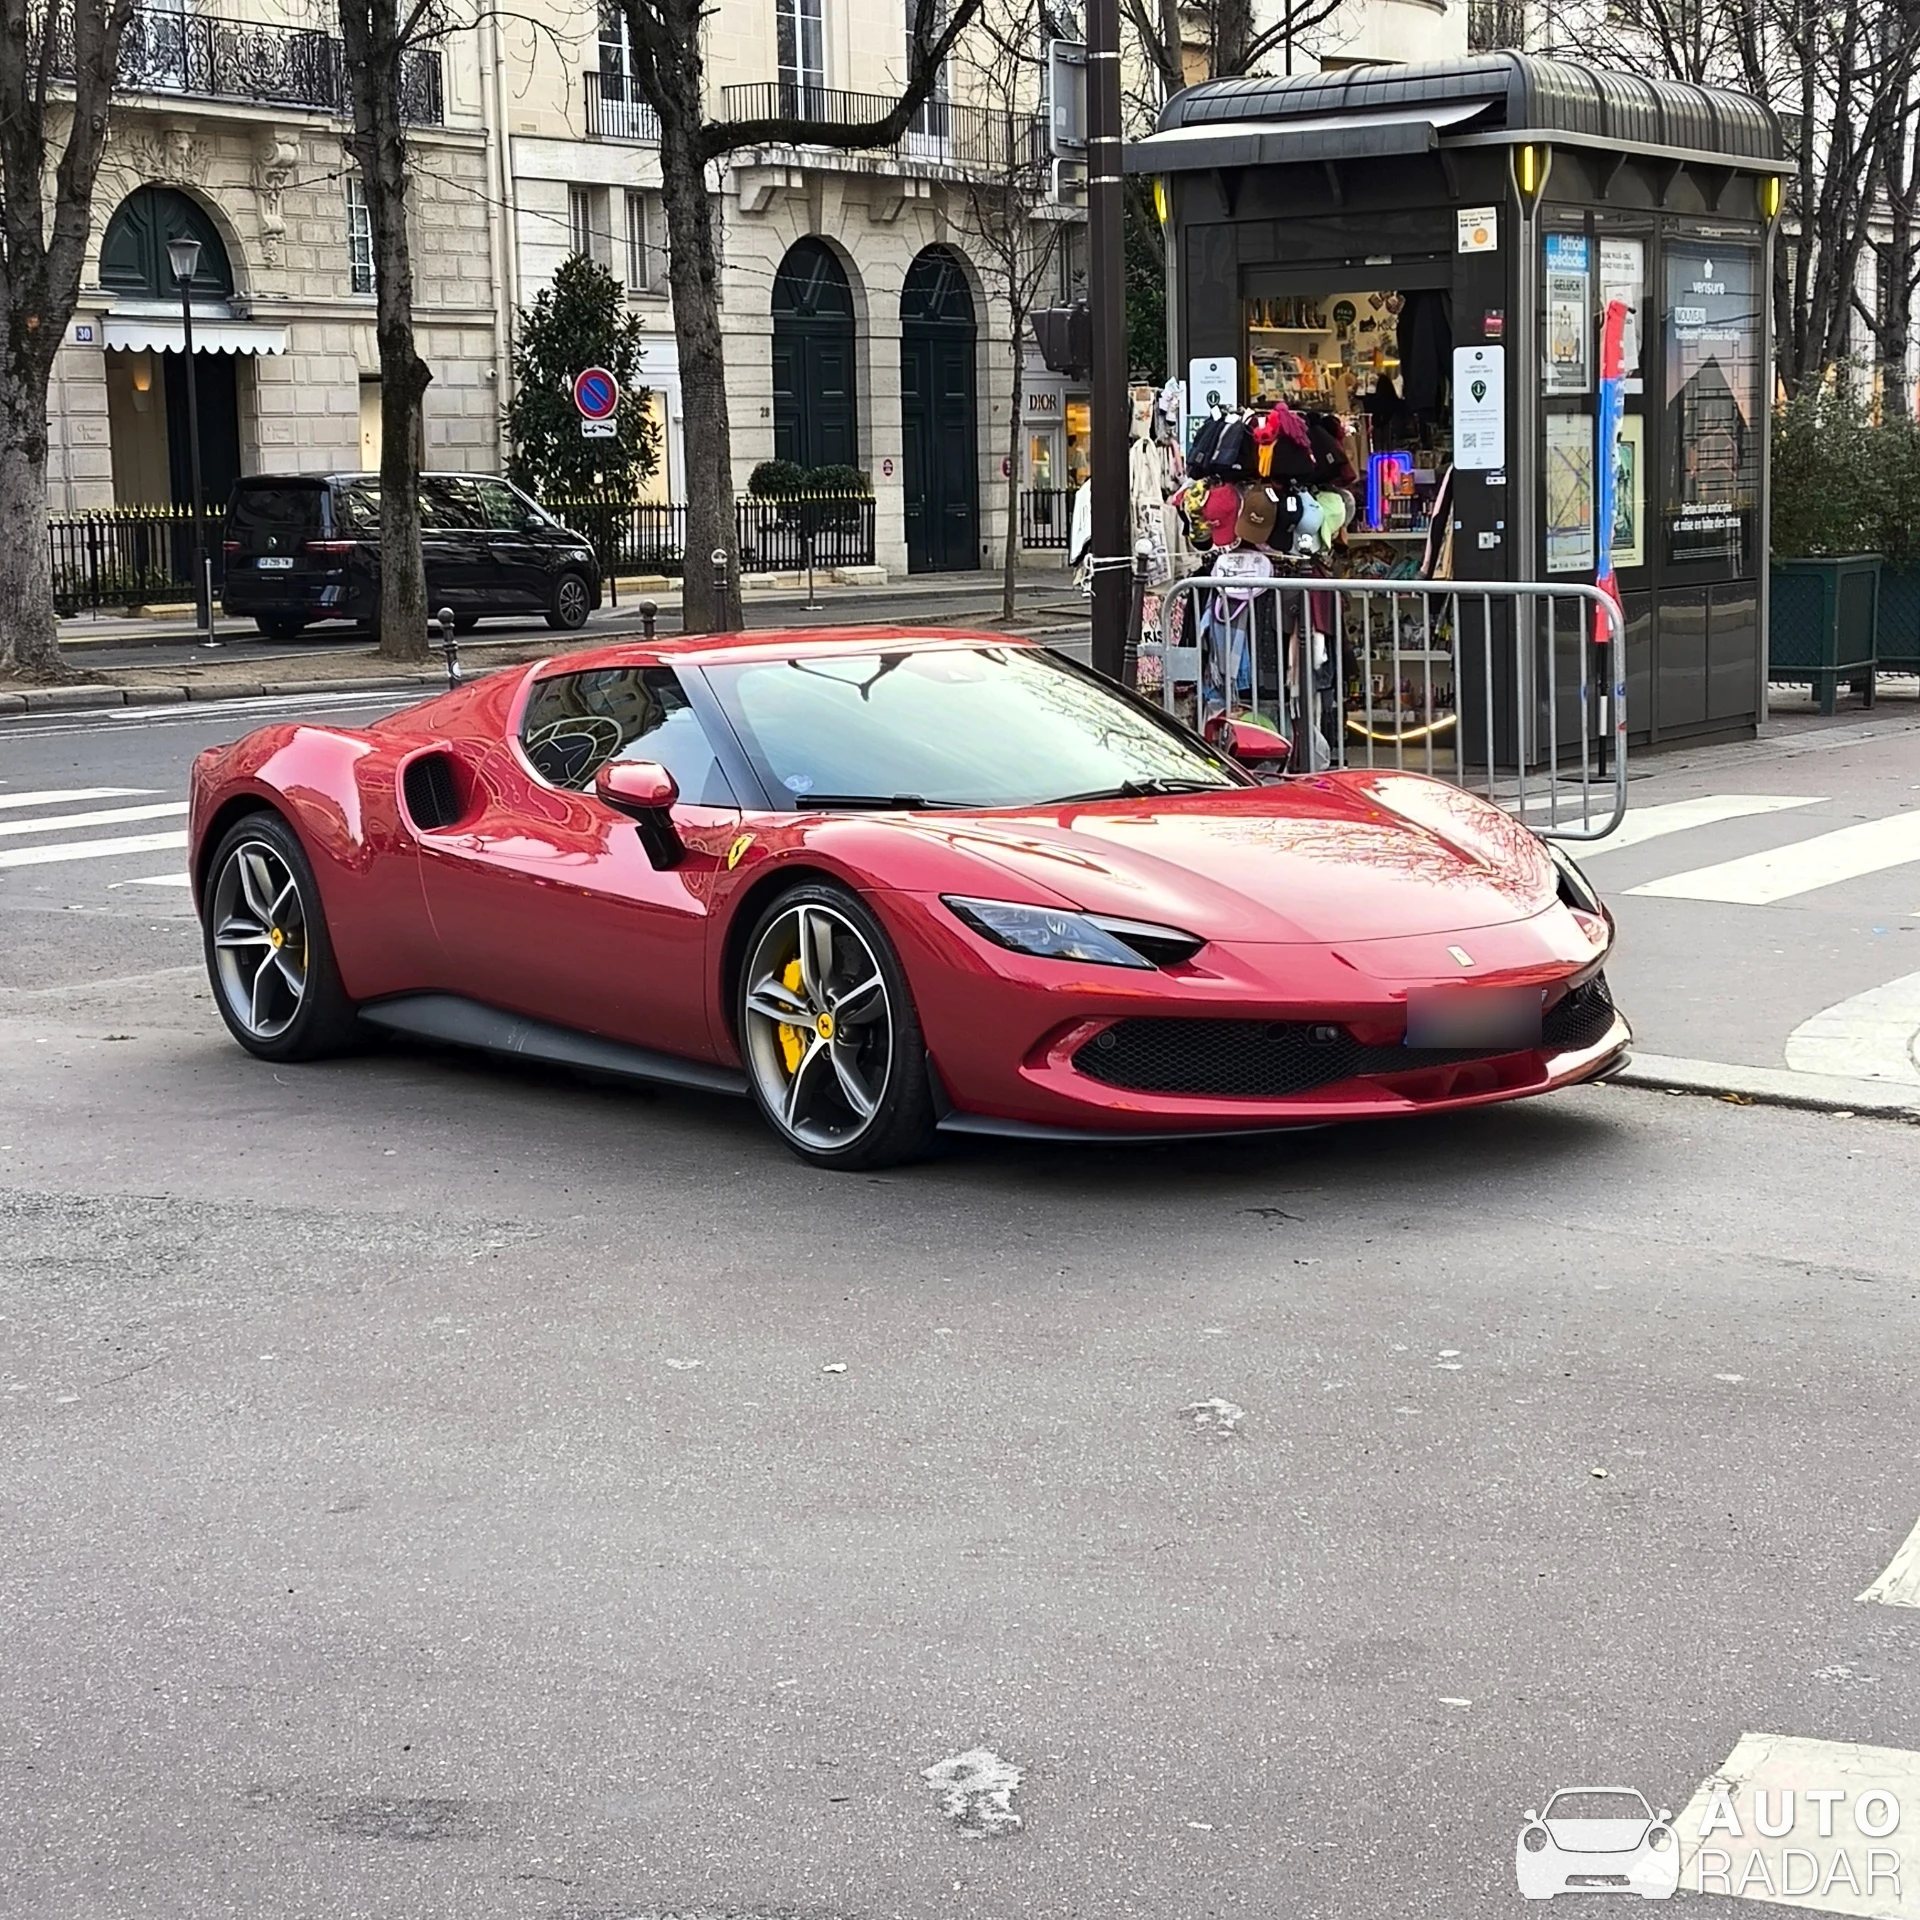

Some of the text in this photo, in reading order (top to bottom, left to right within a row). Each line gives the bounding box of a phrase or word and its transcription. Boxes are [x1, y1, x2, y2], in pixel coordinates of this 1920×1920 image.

[1554, 279, 1580, 291] GELUCK
[78, 327, 91, 340] 30
[1029, 394, 1057, 411] DIOR
[1673, 521, 1680, 531] et
[1715, 516, 1725, 528] des
